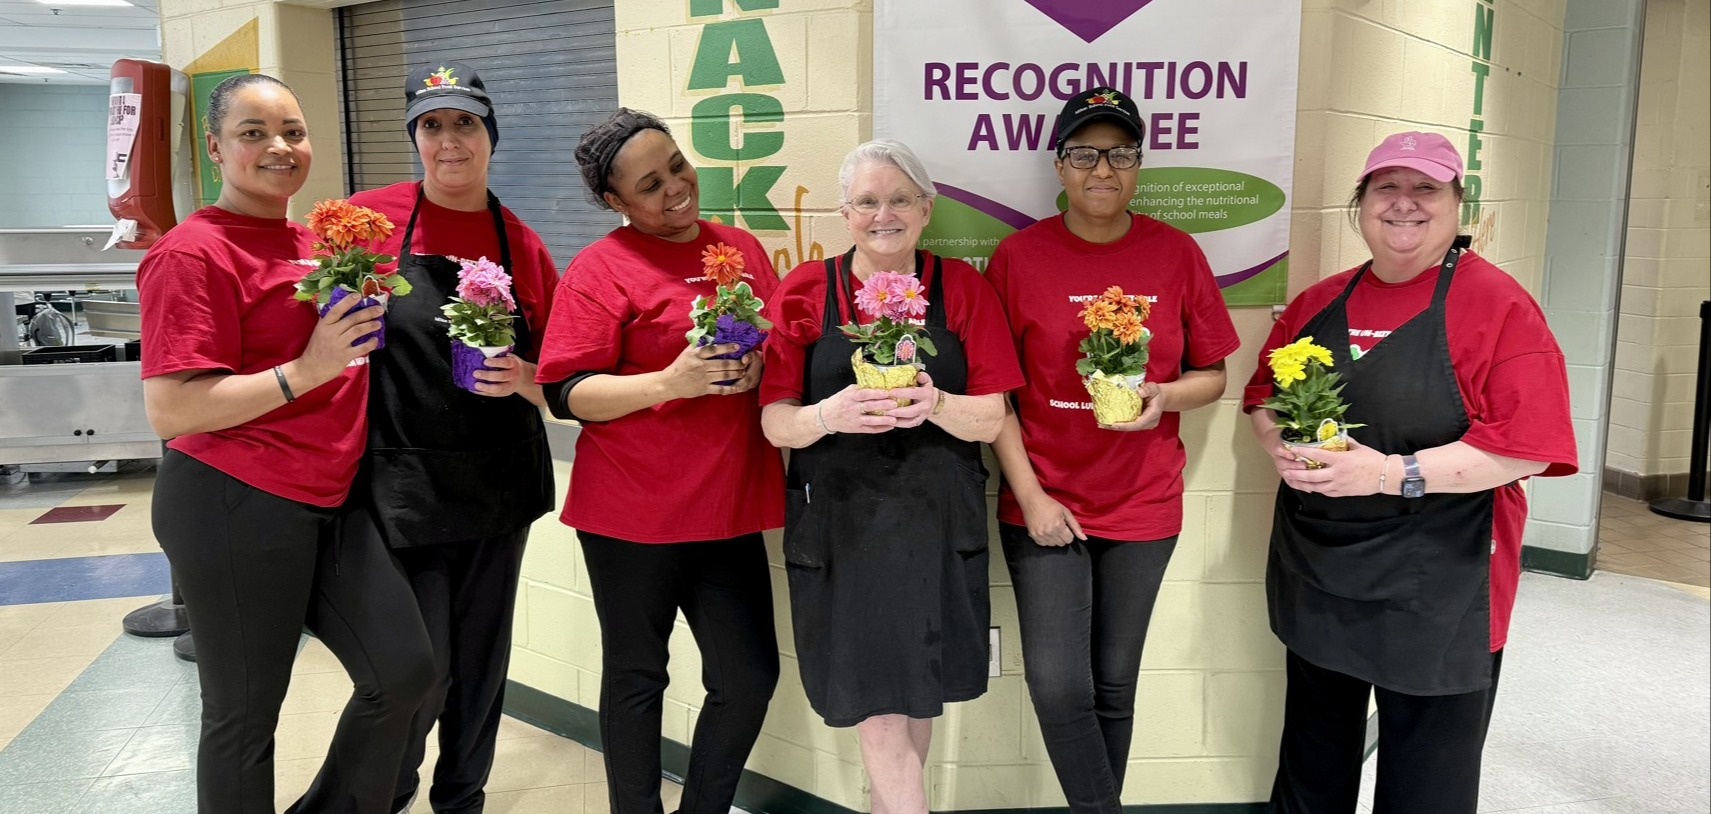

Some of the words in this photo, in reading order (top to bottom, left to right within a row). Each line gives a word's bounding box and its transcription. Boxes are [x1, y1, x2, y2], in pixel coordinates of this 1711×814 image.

[924, 61, 1247, 101] RECOGNITION
[687, 0, 791, 231] ACK
[1461, 0, 1494, 226] NTER
[967, 112, 1200, 151] AWEE
[1133, 182, 1170, 195] gnition
[1172, 181, 1184, 192] of
[1185, 181, 1245, 194] exceptional
[1129, 196, 1184, 208] enhancing
[1187, 196, 1204, 206] the
[1206, 194, 1259, 206] nutritional
[1150, 209, 1162, 220] of
[1163, 209, 1196, 220] school
[1199, 209, 1228, 219] meals
[923, 236, 978, 248] partnership
[980, 237, 1000, 246] with
[1049, 399, 1080, 409] SCHOOL
